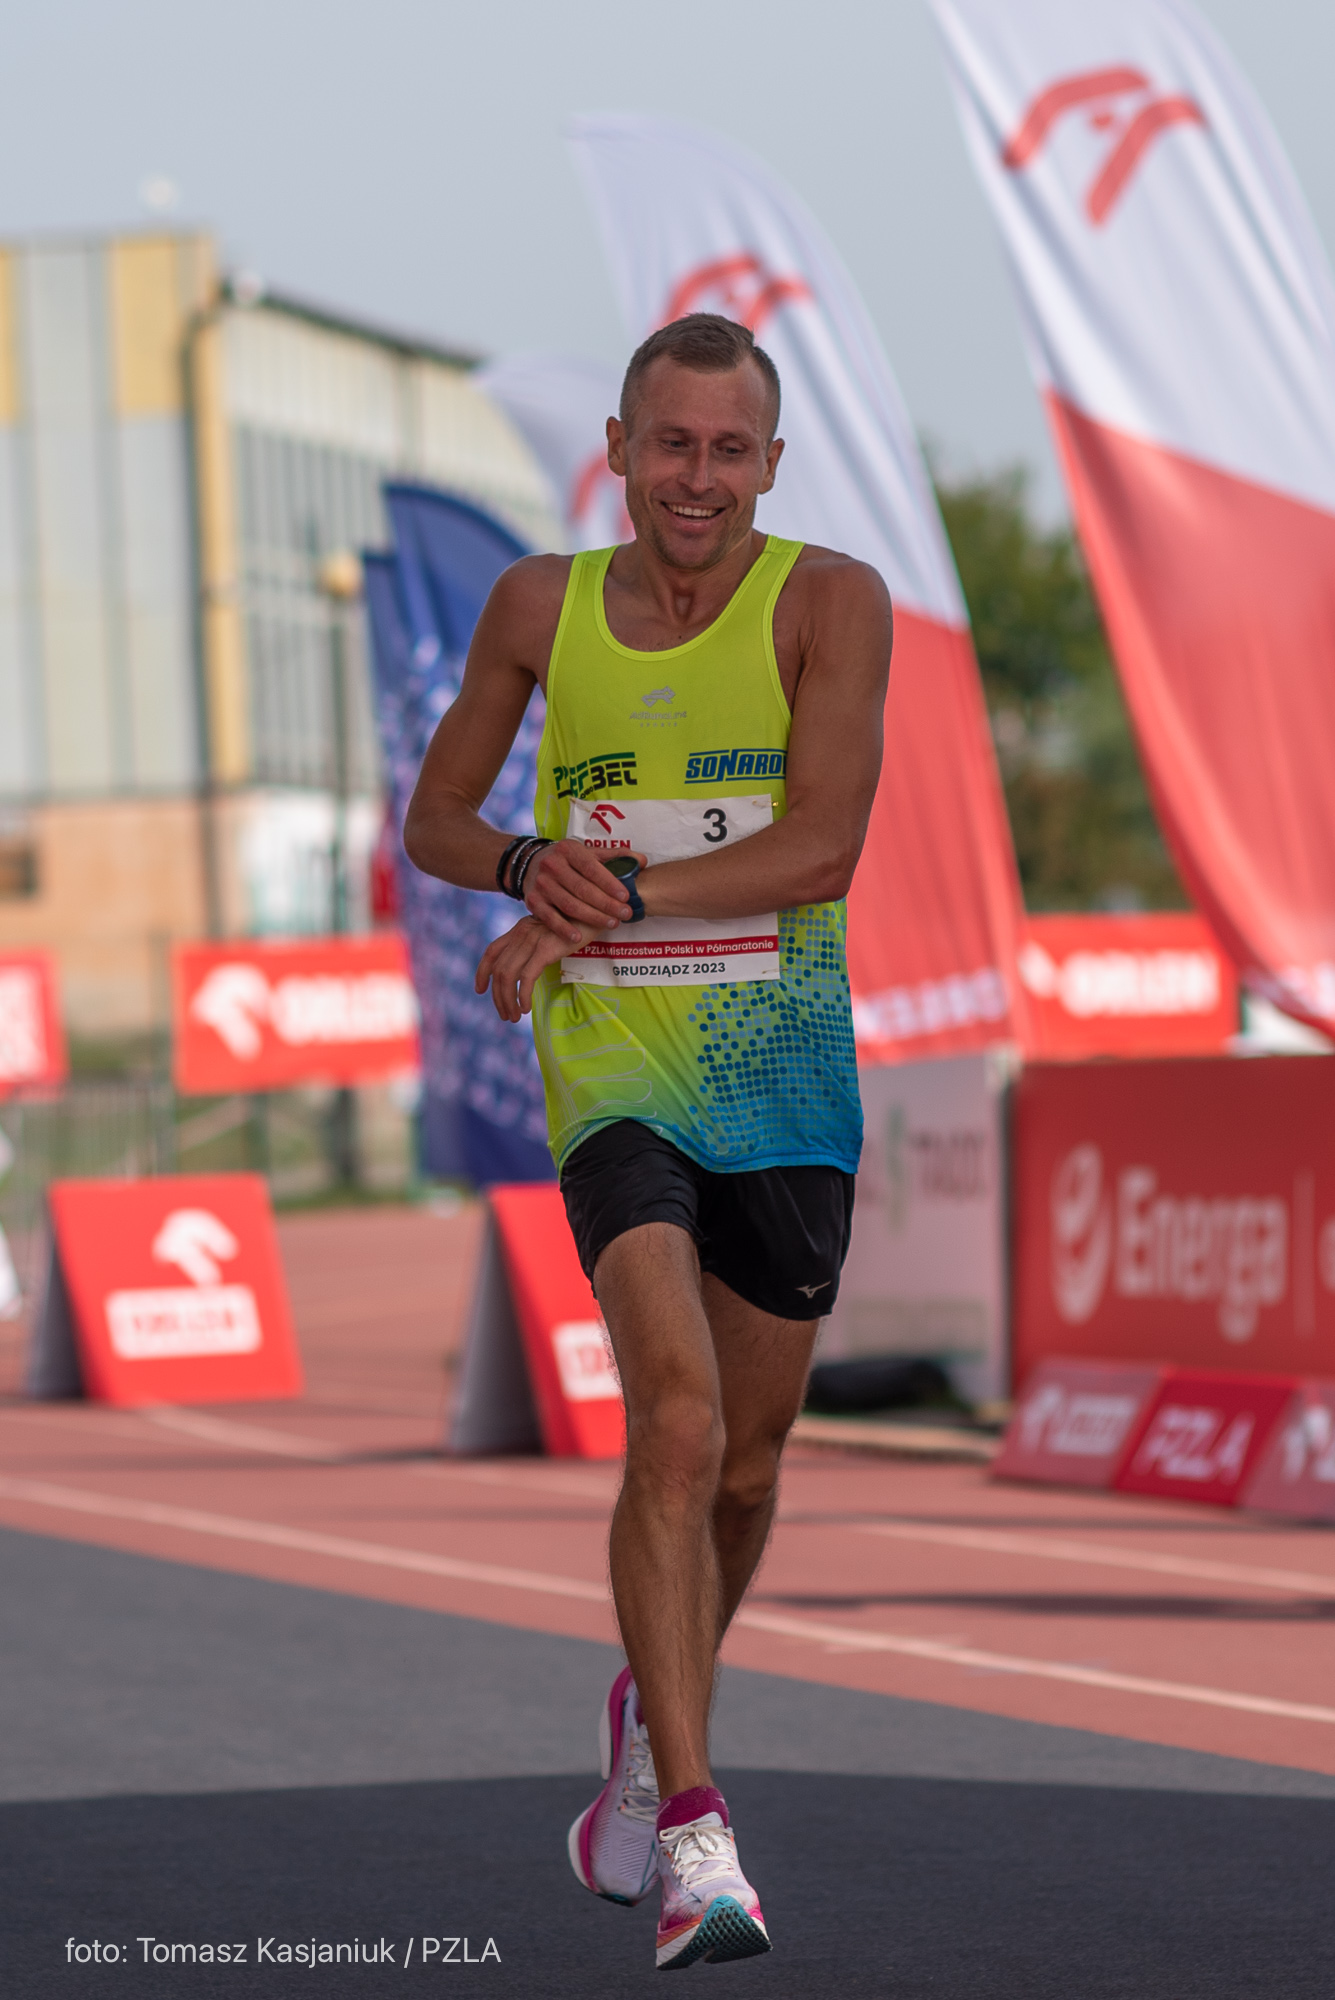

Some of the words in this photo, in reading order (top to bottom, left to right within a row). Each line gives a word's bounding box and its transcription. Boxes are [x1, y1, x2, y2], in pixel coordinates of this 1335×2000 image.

[703, 808, 728, 842] 3
[664, 944, 694, 955] Polski
[695, 946, 705, 954] w
[612, 965, 690, 977] GRUDZIĄDZ
[692, 962, 726, 974] 2023
